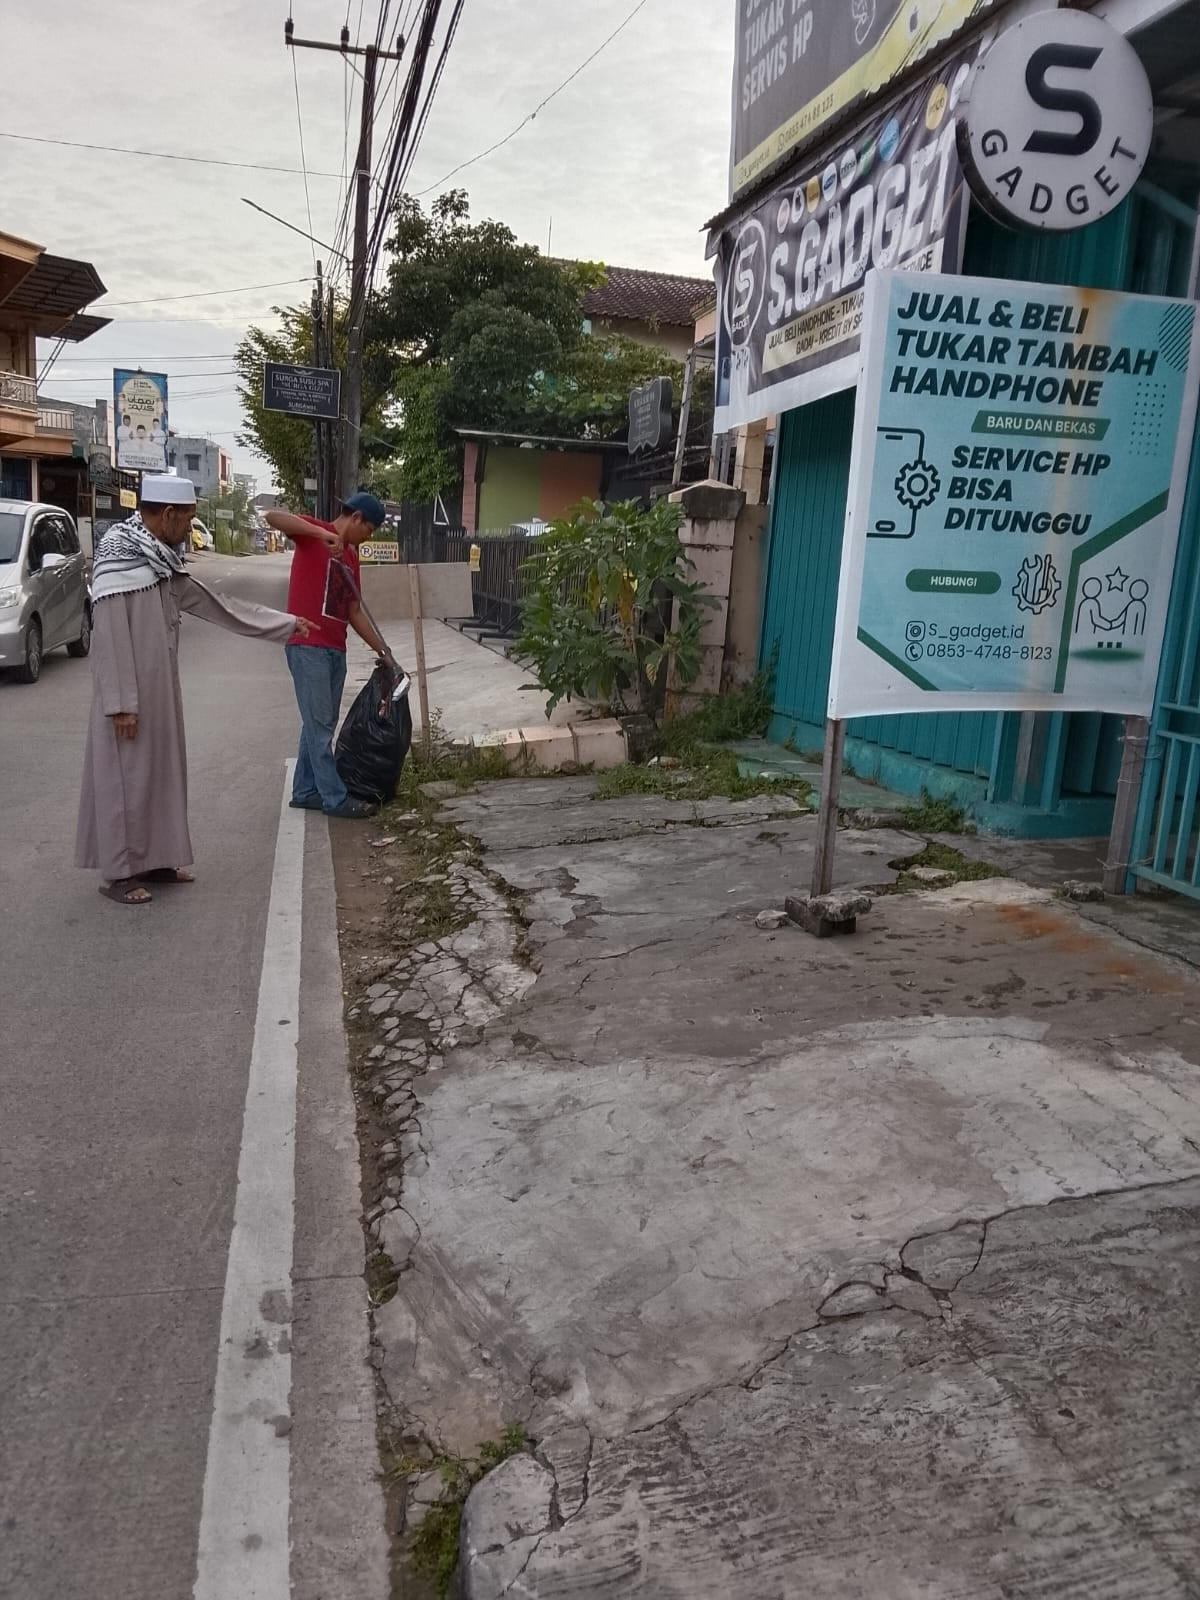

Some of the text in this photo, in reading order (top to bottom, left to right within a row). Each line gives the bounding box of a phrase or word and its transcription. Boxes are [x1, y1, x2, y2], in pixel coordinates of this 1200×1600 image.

[745, 0, 785, 64] TUKAR
[743, 10, 813, 112] SERVIS HP
[1022, 42, 1103, 156] S
[981, 129, 1137, 215] GADGET
[767, 118, 956, 326] S.GADGET
[768, 332, 782, 349] JUAL
[785, 327, 797, 343] BELI
[797, 305, 836, 338] HANDPHONE
[897, 292, 1089, 334] JUAL & BELI
[819, 325, 842, 345] KREDIT
[896, 329, 1159, 376] TUKAR TAMBAH
[889, 367, 1103, 407] HANDPHONE
[987, 416, 1096, 434] BARU DAN BEKAS
[951, 446, 1111, 477] SERVICE HP
[948, 477, 1013, 502] BISA
[944, 508, 1092, 535] DITUNGGU
[930, 576, 978, 588] HUBUNGI
[926, 643, 1052, 661] 0853-4748-8123
[928, 624, 1025, 642] S_gadget.id
